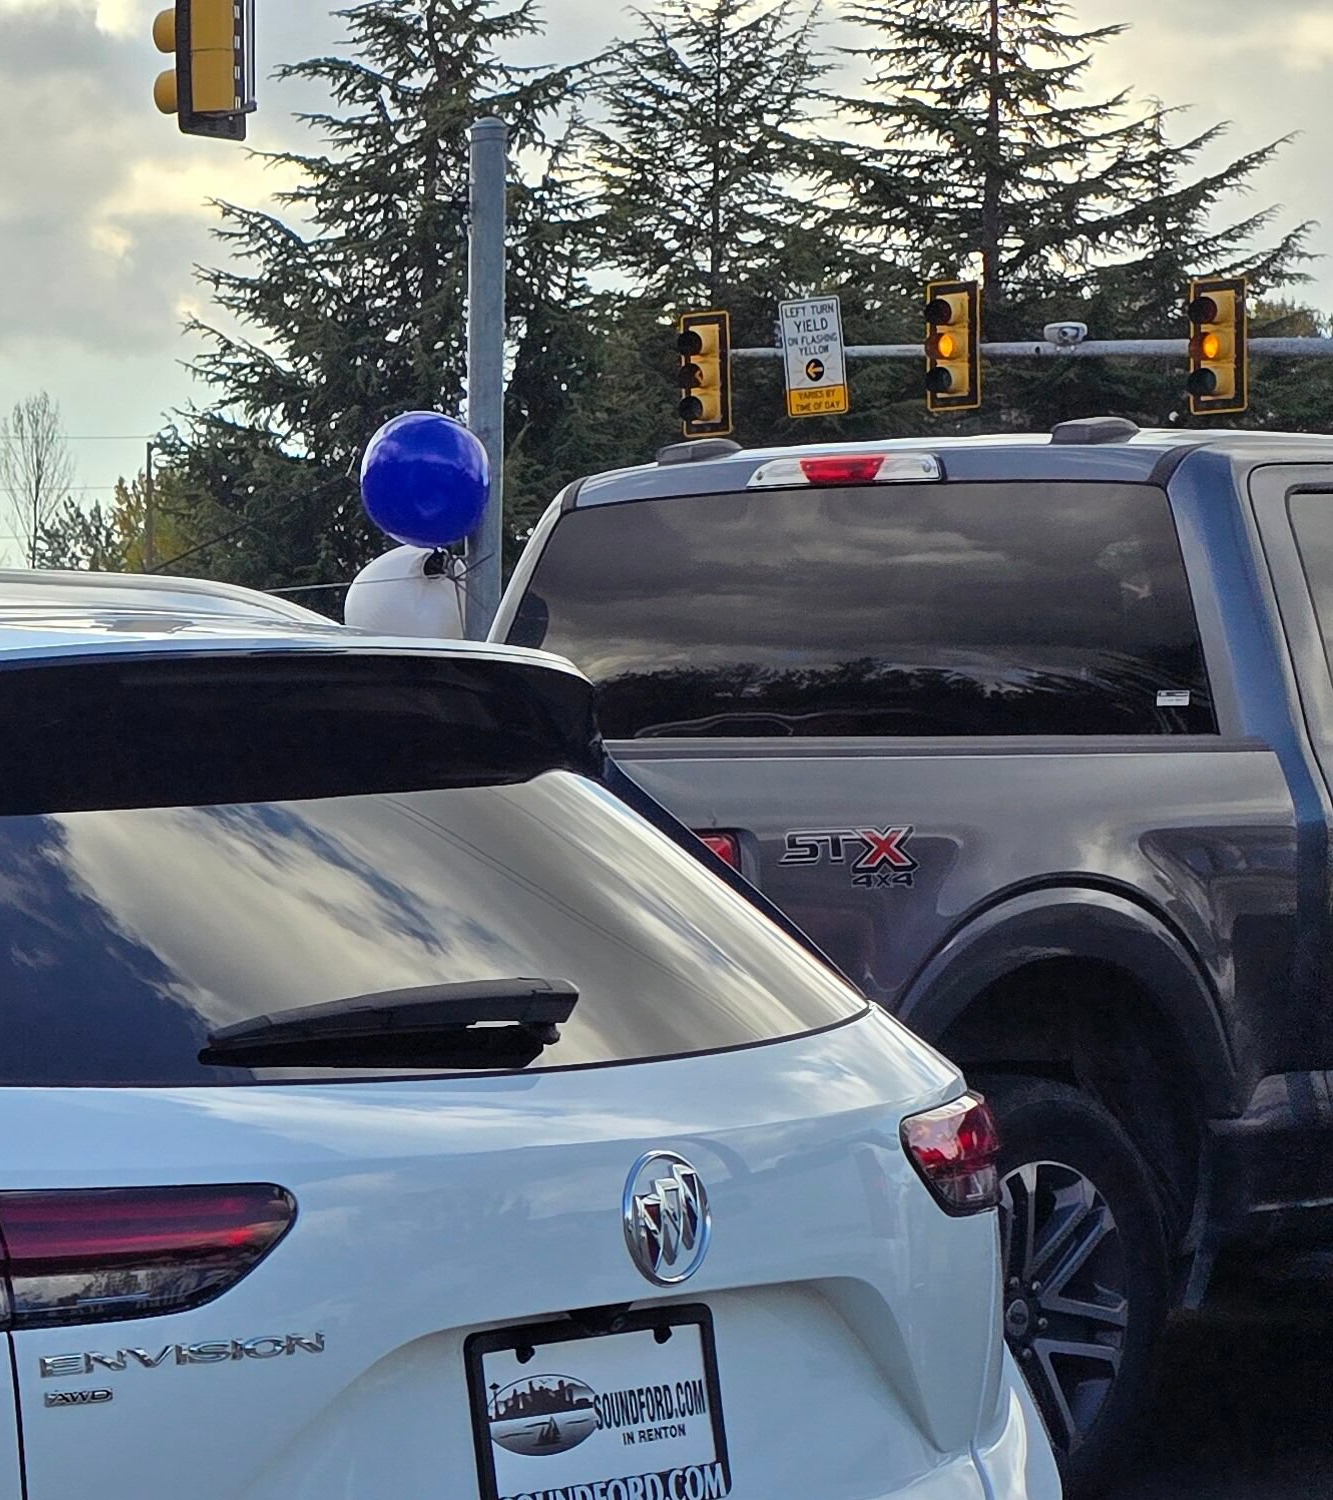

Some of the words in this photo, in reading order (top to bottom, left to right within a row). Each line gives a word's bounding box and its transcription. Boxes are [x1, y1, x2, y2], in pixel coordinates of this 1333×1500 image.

[784, 306, 806, 318] LEFT
[810, 303, 835, 315] TURN
[793, 317, 829, 333] YIELD
[788, 336, 799, 347] ON
[801, 332, 837, 346] FLASHING
[799, 344, 829, 356] YELLOW
[797, 390, 824, 401] VARIES
[825, 388, 836, 399] BY
[796, 403, 812, 412] TIME
[813, 402, 822, 411] OF
[824, 400, 840, 410] DAY
[778, 824, 919, 874] STX
[39, 1331, 325, 1378] ENVISION
[48, 1389, 113, 1406] AWD
[593, 1379, 706, 1430] SOUNDFORD.COM
[623, 1431, 634, 1446] IN
[639, 1423, 687, 1443] RENTON
